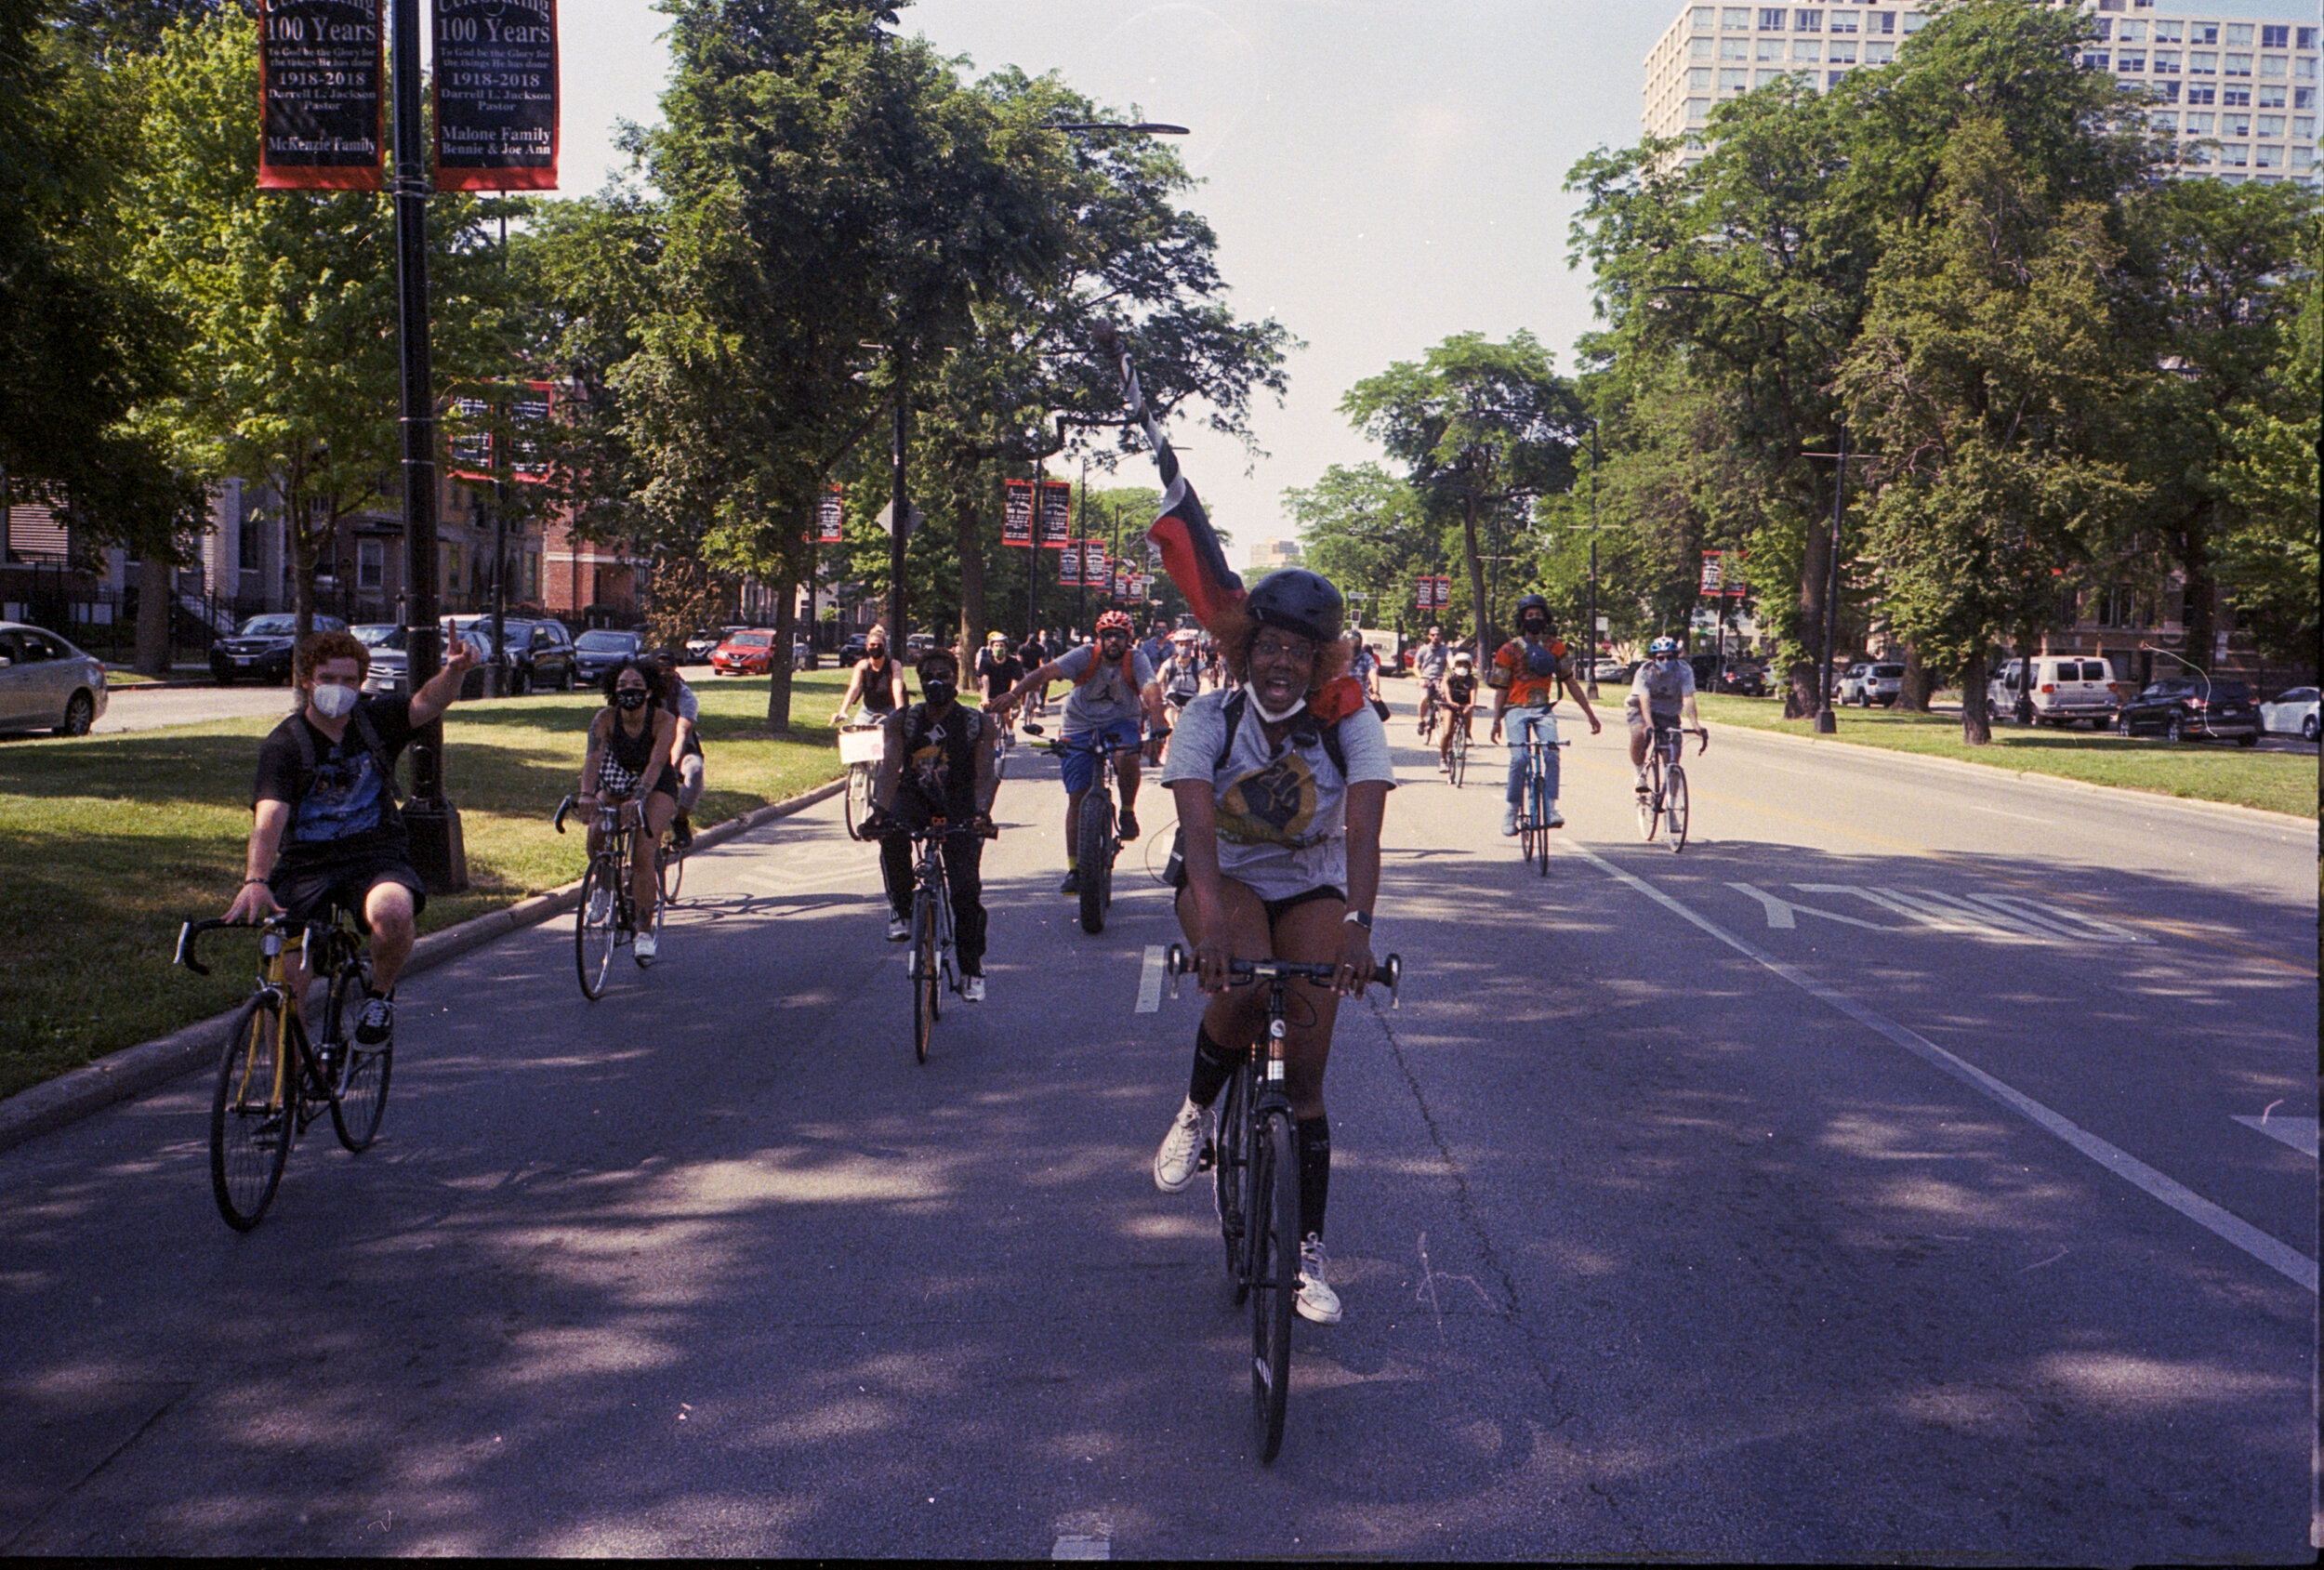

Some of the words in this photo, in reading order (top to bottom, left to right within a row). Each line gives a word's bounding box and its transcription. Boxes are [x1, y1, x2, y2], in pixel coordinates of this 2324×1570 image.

[267, 17, 304, 41] 100
[310, 17, 376, 41] Years
[440, 17, 477, 42] 100
[484, 18, 550, 43] Years
[455, 47, 475, 56] God
[477, 47, 489, 56] be
[491, 48, 506, 57] the
[508, 48, 534, 59] Glory
[536, 49, 550, 58] for
[318, 58, 331, 66] He
[461, 59, 490, 69] things
[279, 72, 365, 86] 1918-2018
[453, 73, 540, 86] 1918-2018
[269, 88, 311, 99] Darrell
[329, 89, 376, 99] Jackson
[441, 88, 484, 99] Darrell
[503, 90, 551, 100] Jackson
[304, 100, 342, 111] Pastor
[478, 100, 517, 111] Pastor
[442, 125, 496, 140] Malone
[501, 126, 551, 144] Family
[268, 136, 331, 151] McKenzie
[334, 137, 376, 154] Family
[442, 142, 483, 154] Bennie
[488, 143, 498, 154] &
[501, 142, 522, 154] Joe
[525, 144, 551, 154] Ann
